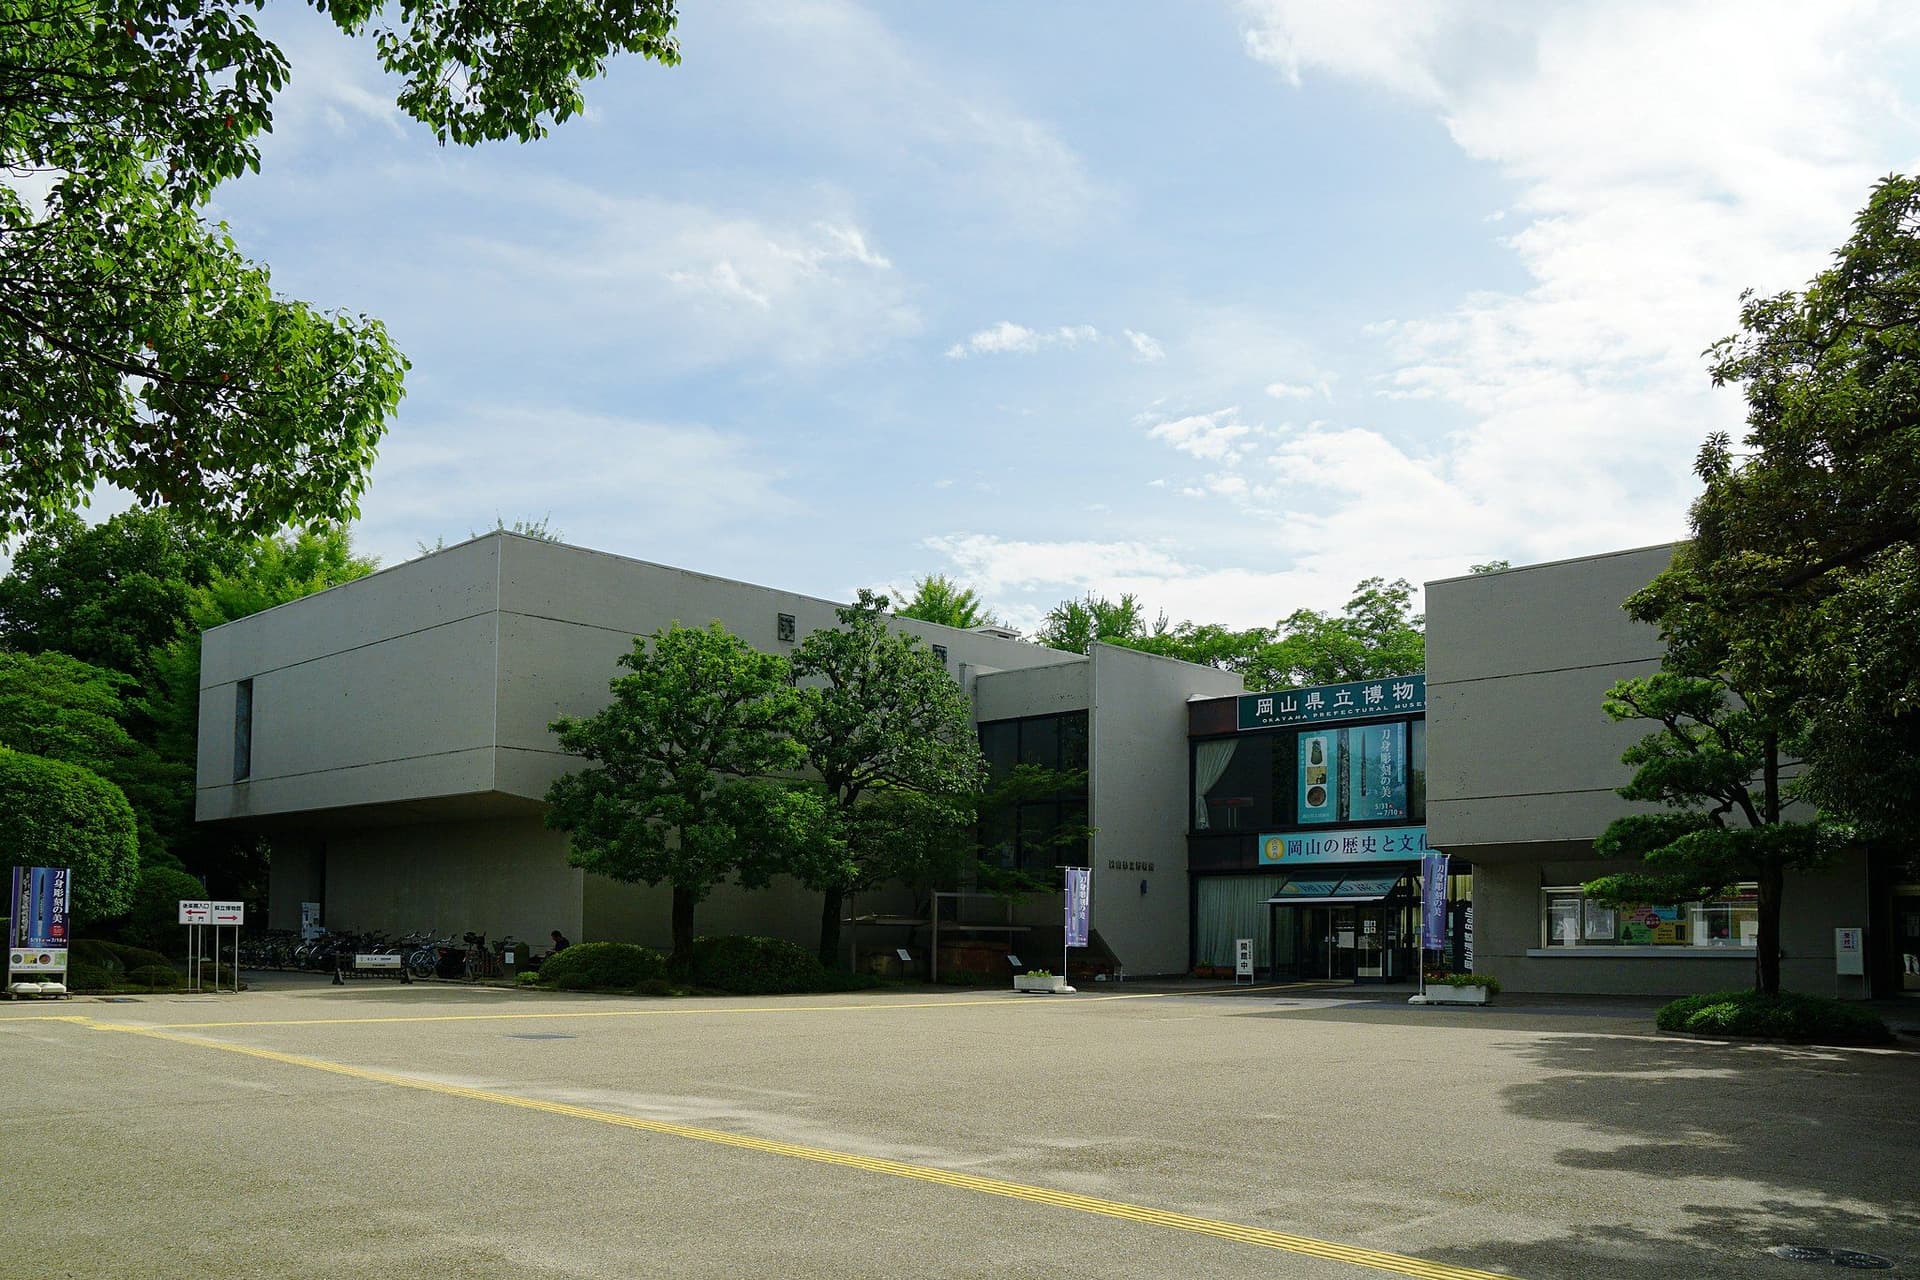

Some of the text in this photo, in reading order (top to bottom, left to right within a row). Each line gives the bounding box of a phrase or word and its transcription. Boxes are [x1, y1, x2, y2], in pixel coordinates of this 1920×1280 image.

[1256, 681, 1425, 717] 岡山県立博物
[1262, 700, 1426, 723] OKAYAMA PREFECTURAL MUSE
[1381, 729, 1392, 798] 刀身彫刻の美
[53, 871, 65, 923] 刀身彫刻の美
